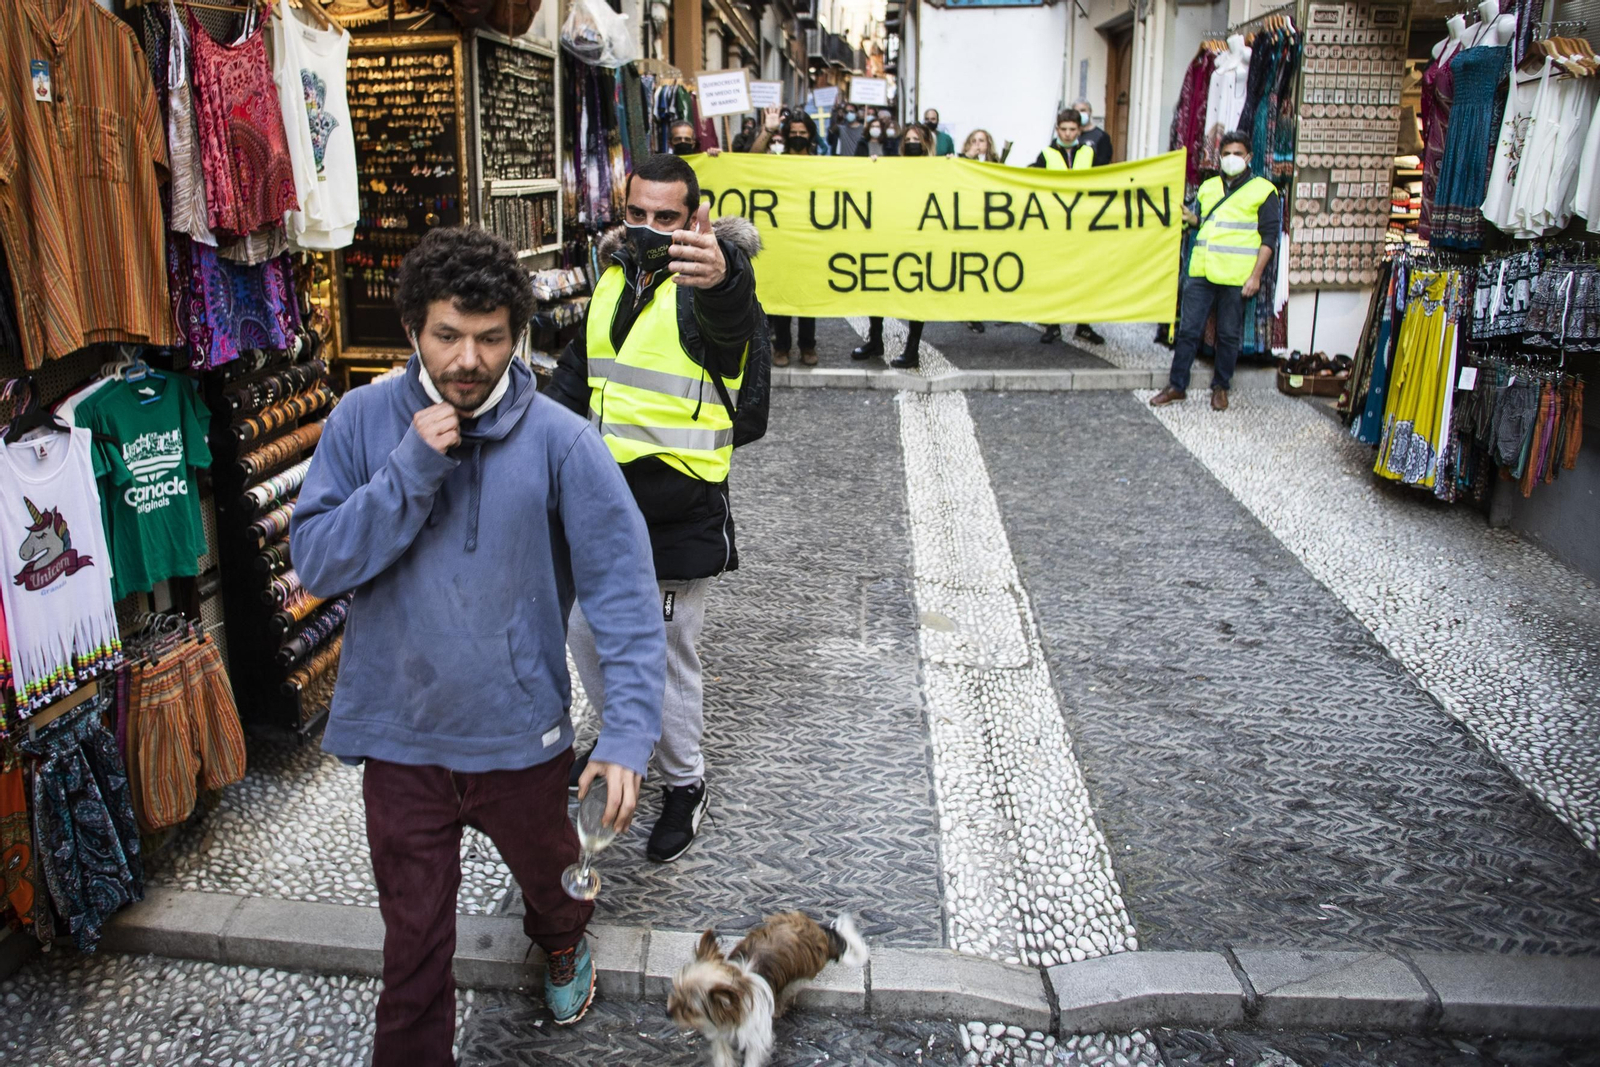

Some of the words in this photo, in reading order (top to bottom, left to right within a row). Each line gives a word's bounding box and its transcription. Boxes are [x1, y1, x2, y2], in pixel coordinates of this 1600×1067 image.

[810, 191, 871, 230] UN
[648, 251, 667, 259] LOCAL
[829, 252, 1023, 292] SEGURO
[124, 475, 188, 507] Canada
[30, 557, 70, 588] Unicorn
